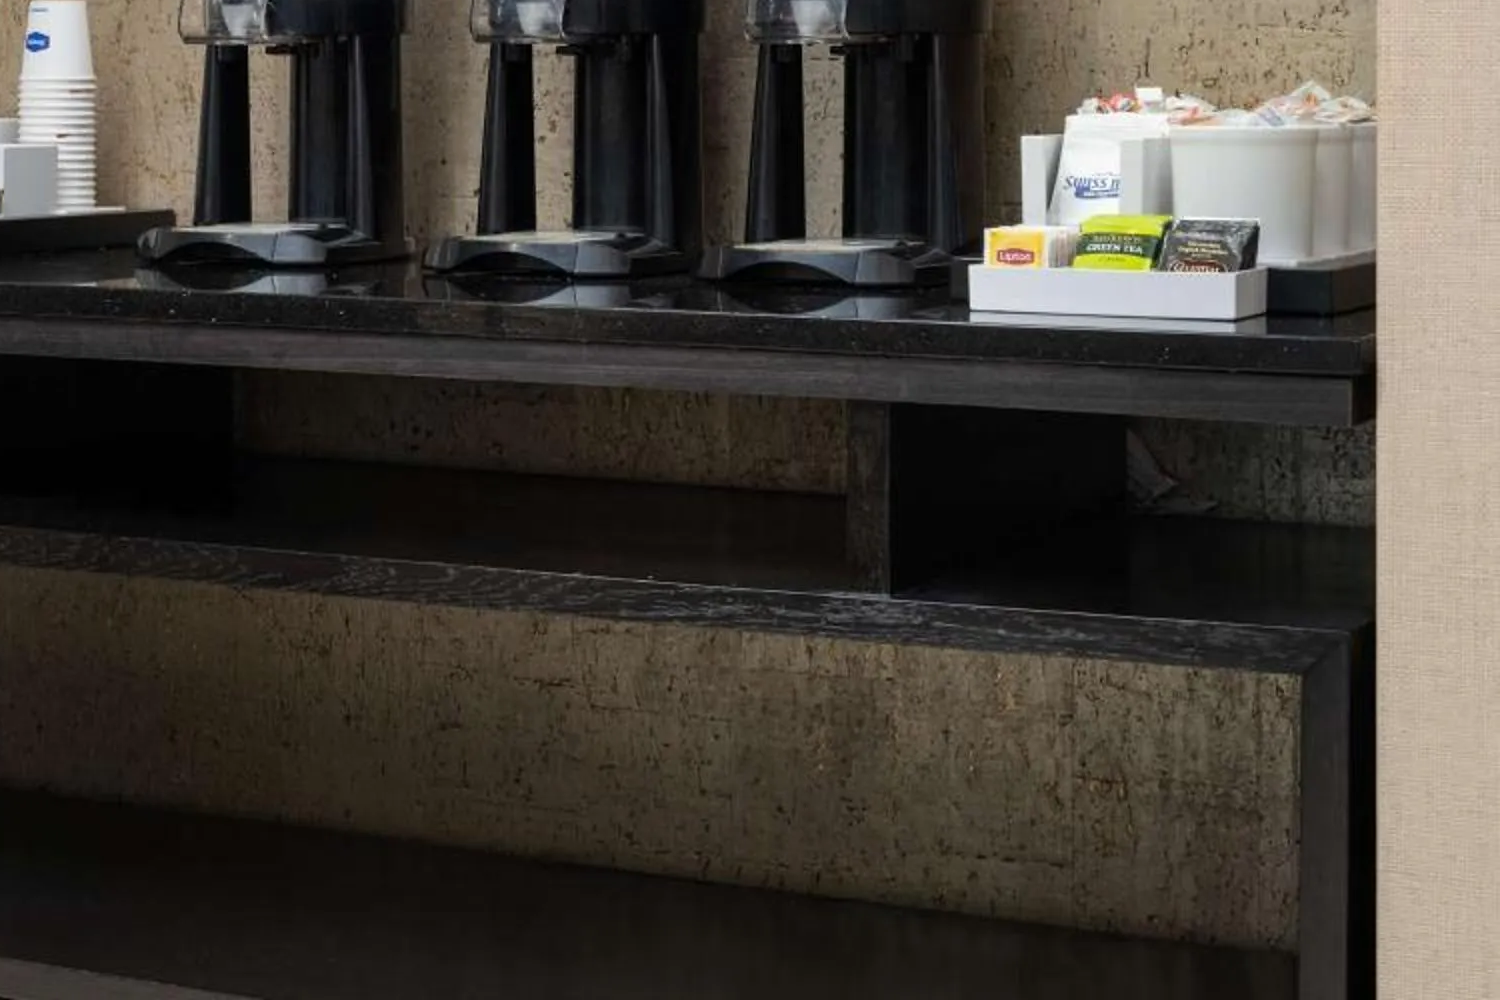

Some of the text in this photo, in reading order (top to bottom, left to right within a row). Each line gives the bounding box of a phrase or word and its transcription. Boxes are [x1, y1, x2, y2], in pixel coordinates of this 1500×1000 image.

[1086, 243, 1143, 255] GREEN TEA
[999, 251, 1032, 262] Lipton
